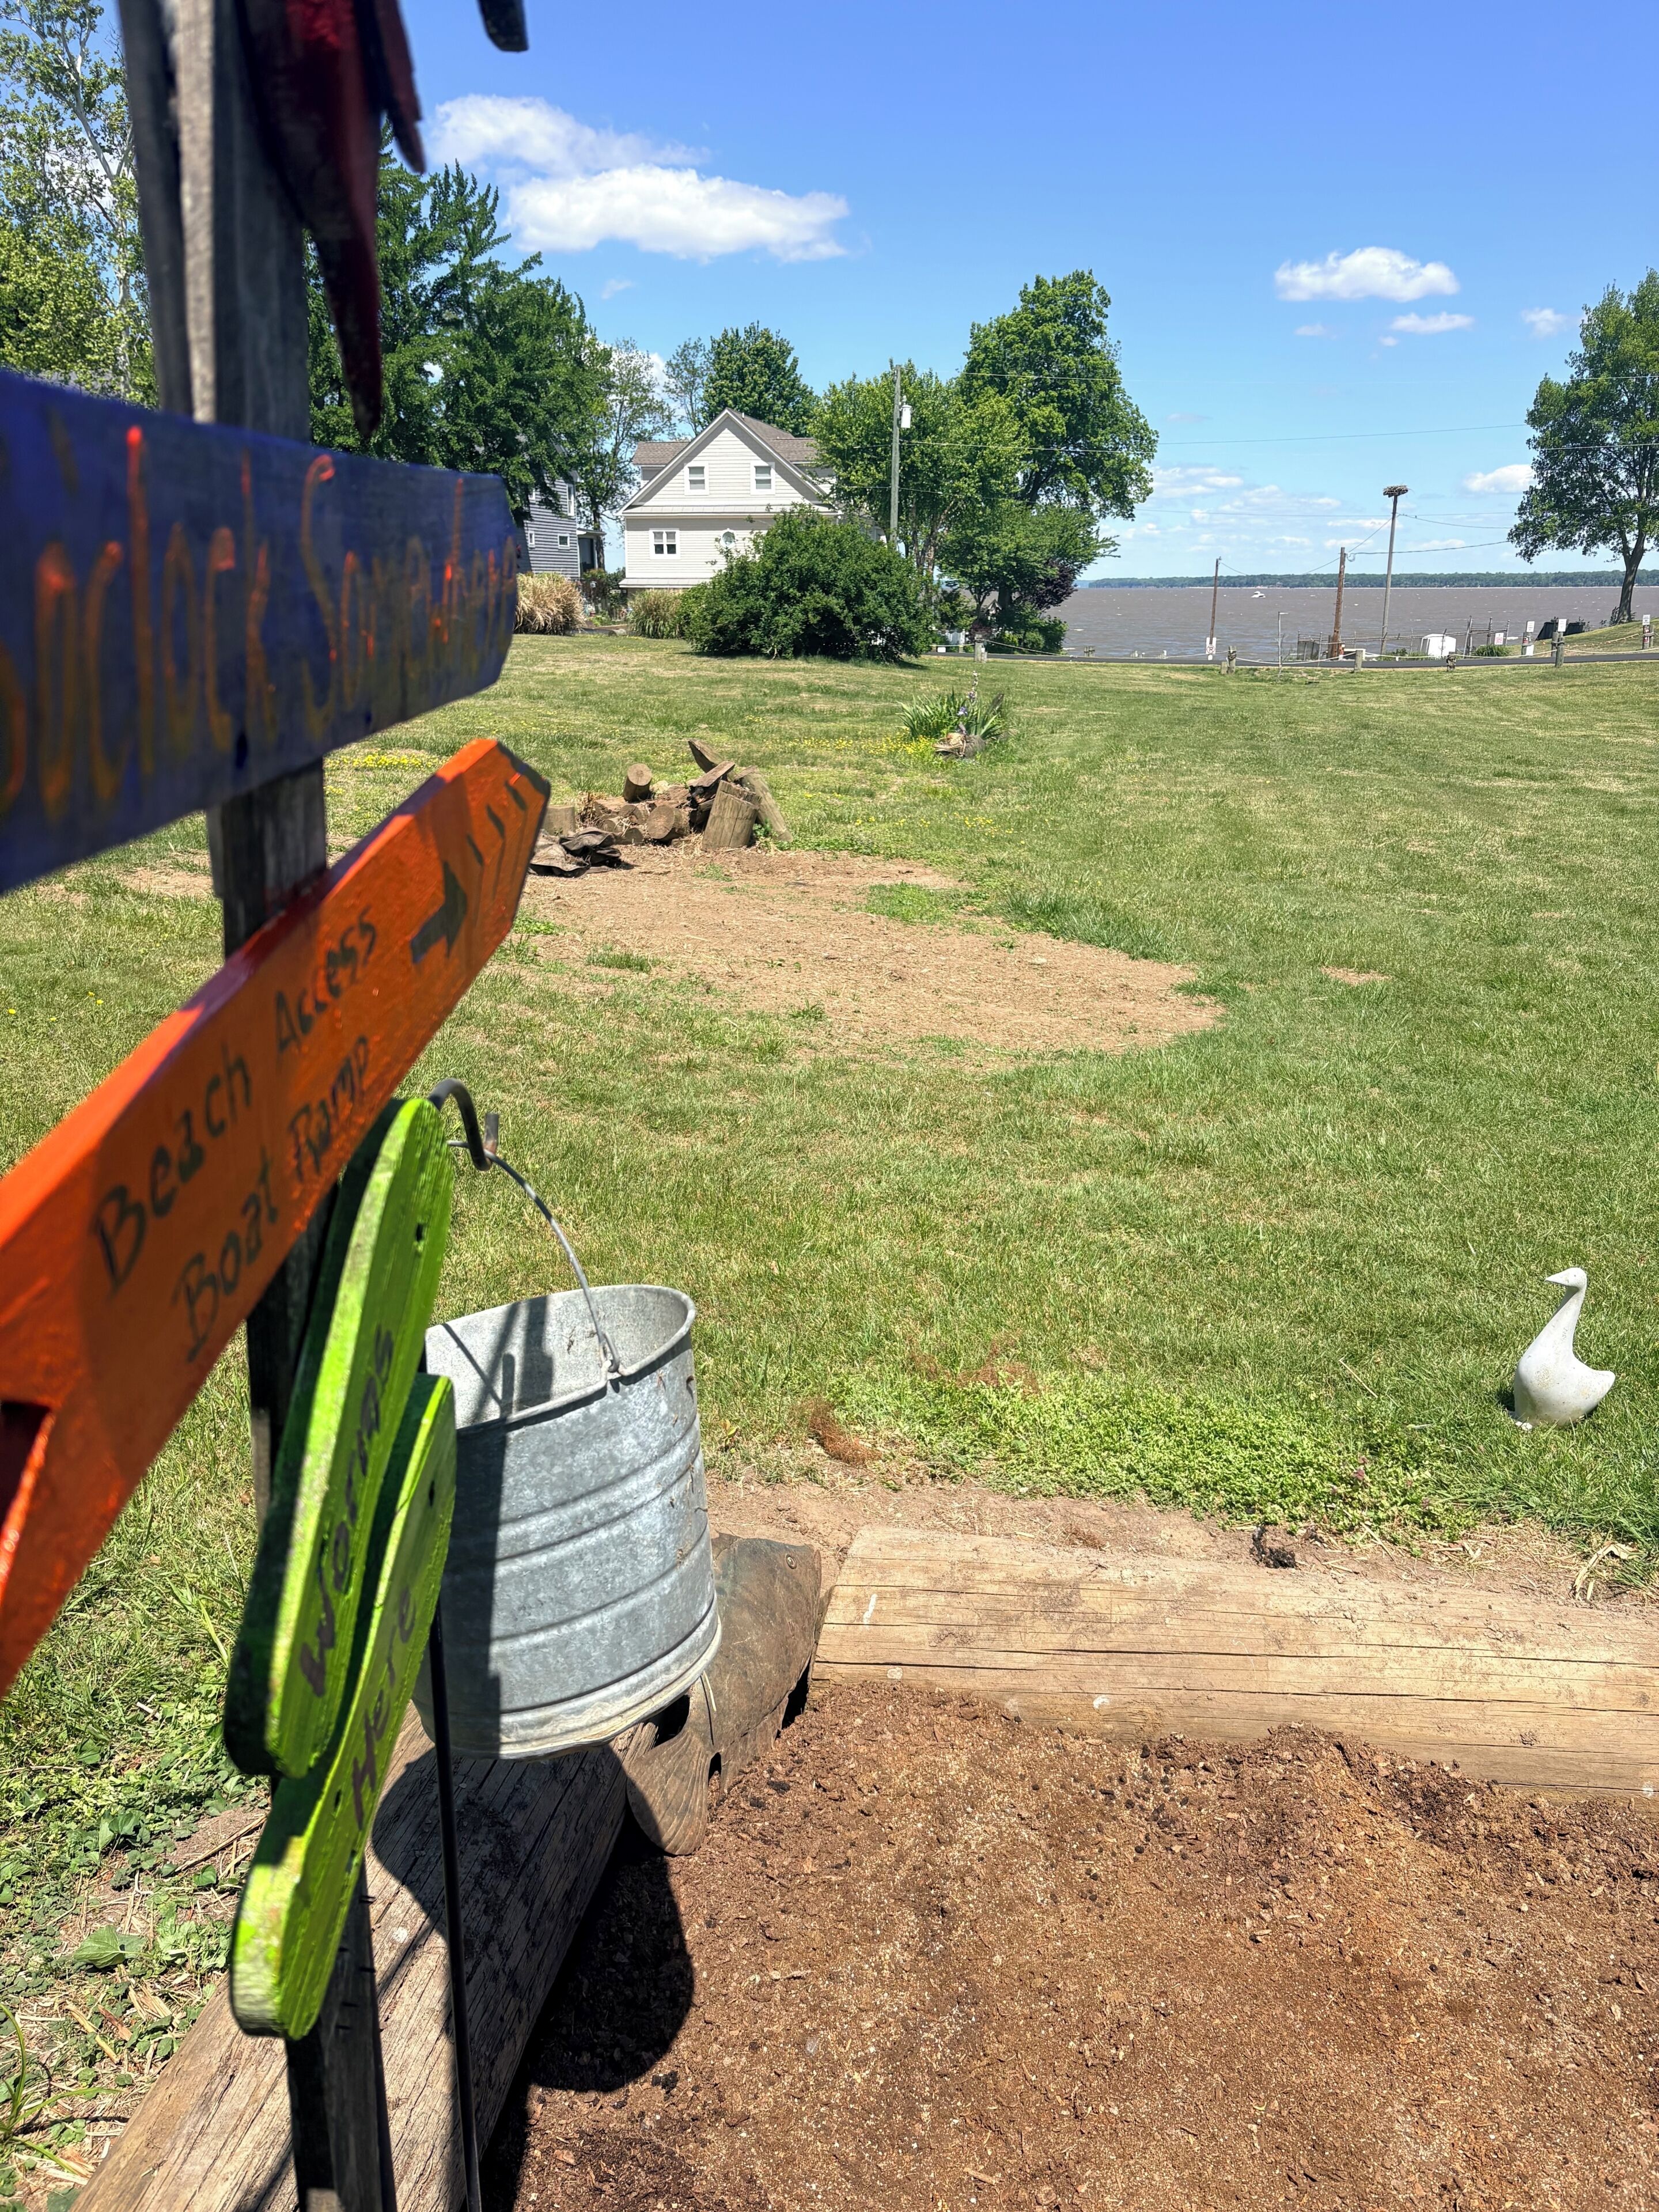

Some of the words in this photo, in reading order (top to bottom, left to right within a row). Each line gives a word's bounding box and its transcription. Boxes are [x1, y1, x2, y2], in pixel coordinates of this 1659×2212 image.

[92, 1050, 252, 1290] Beach
[274, 908, 377, 1063] Access
[175, 1155, 278, 1363] Boat
[288, 1038, 370, 1181] Ramp
[351, 1585, 417, 1830] Here
